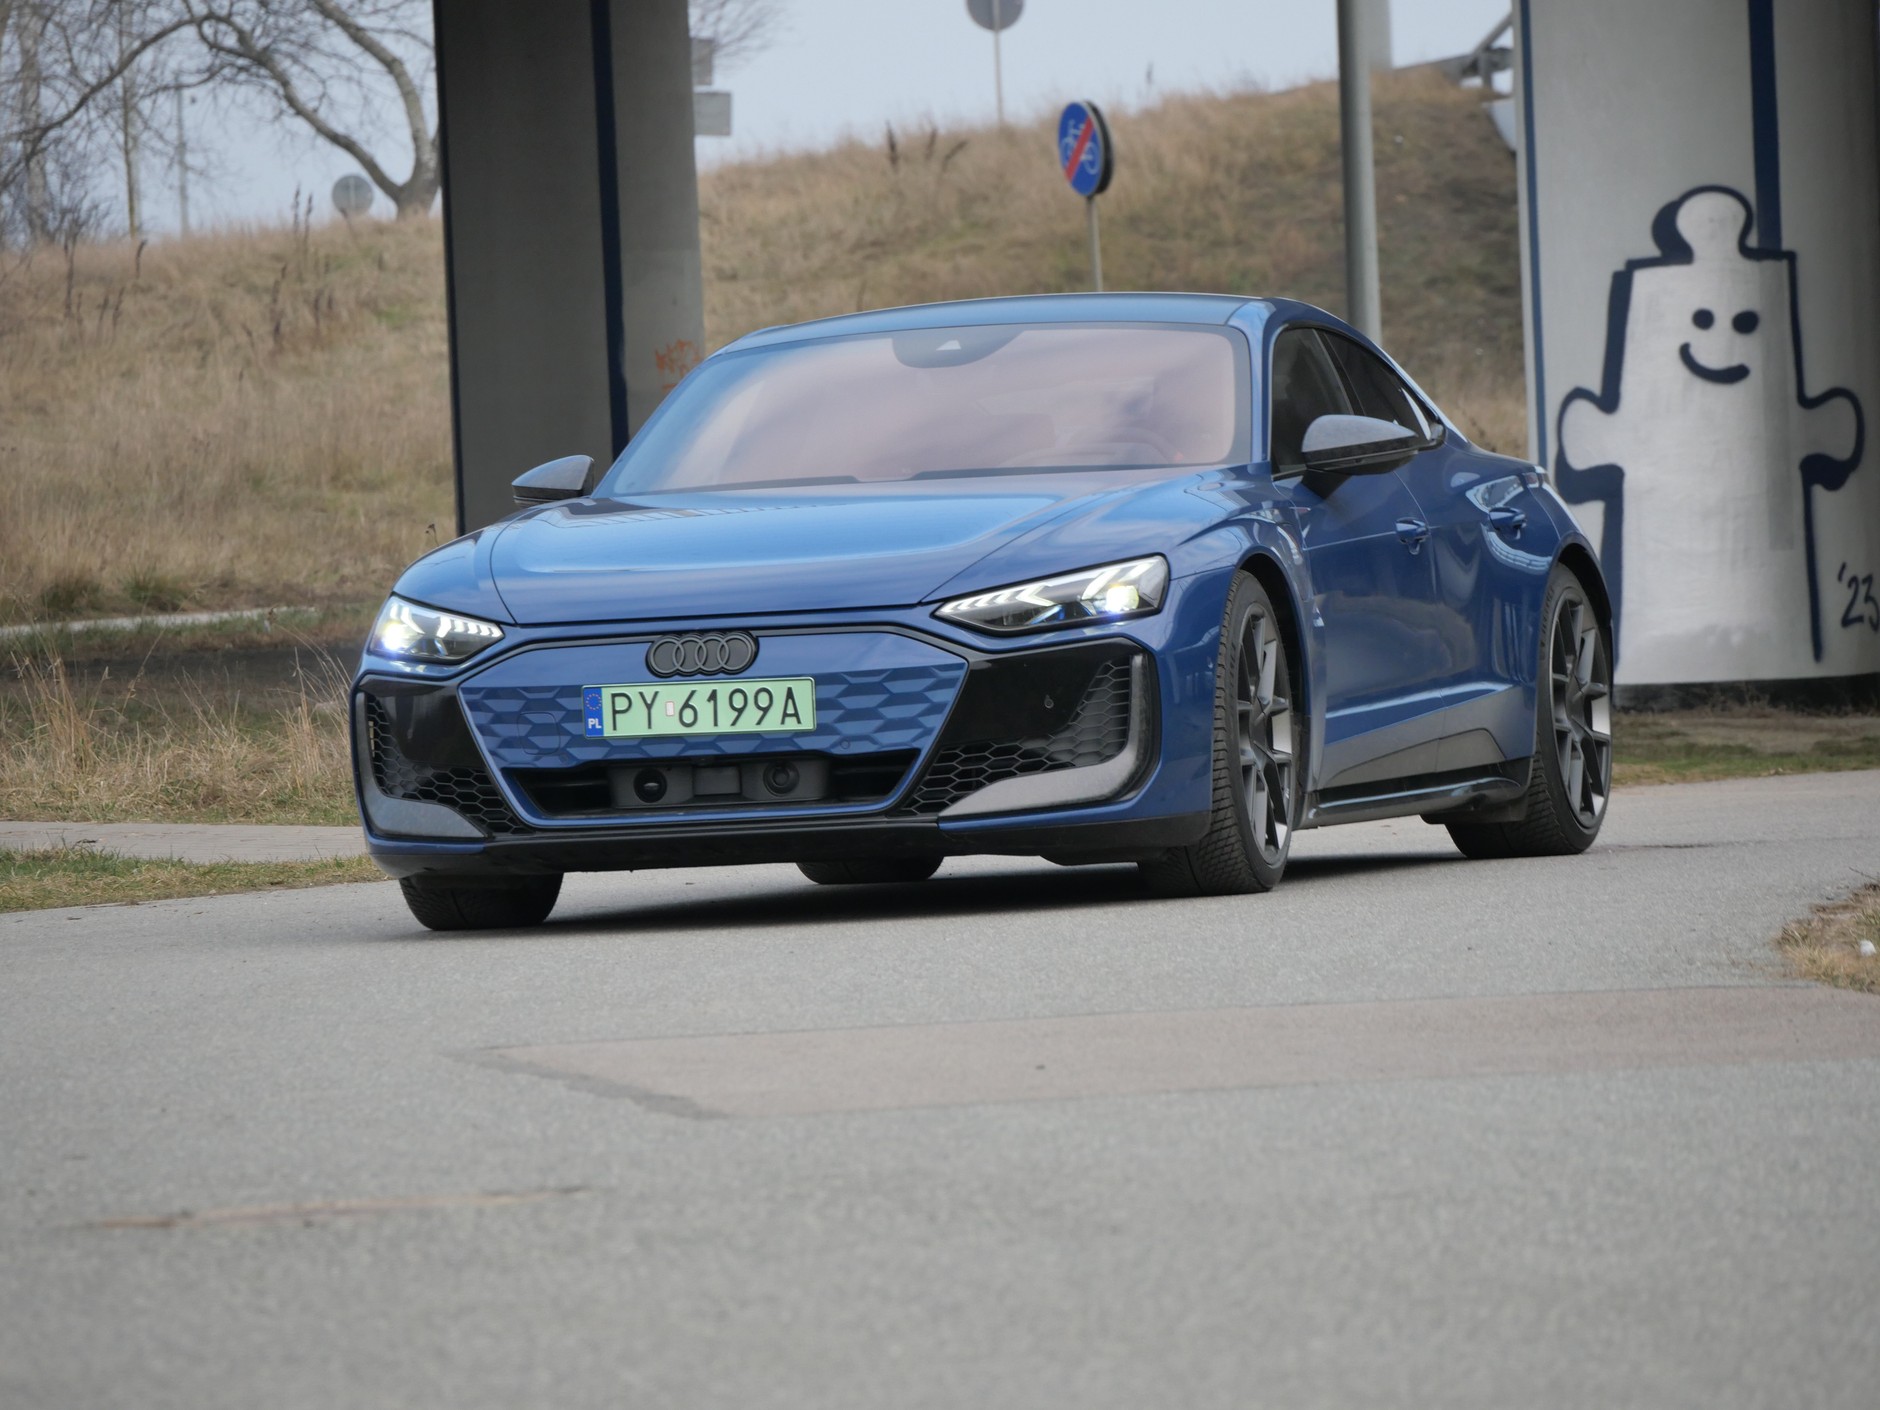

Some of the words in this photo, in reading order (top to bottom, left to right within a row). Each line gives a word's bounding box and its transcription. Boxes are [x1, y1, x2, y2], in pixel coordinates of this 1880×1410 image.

[1837, 562, 1880, 633] '23
[587, 718, 602, 729] PL
[611, 690, 660, 731] PY
[678, 686, 802, 728] 6199A
